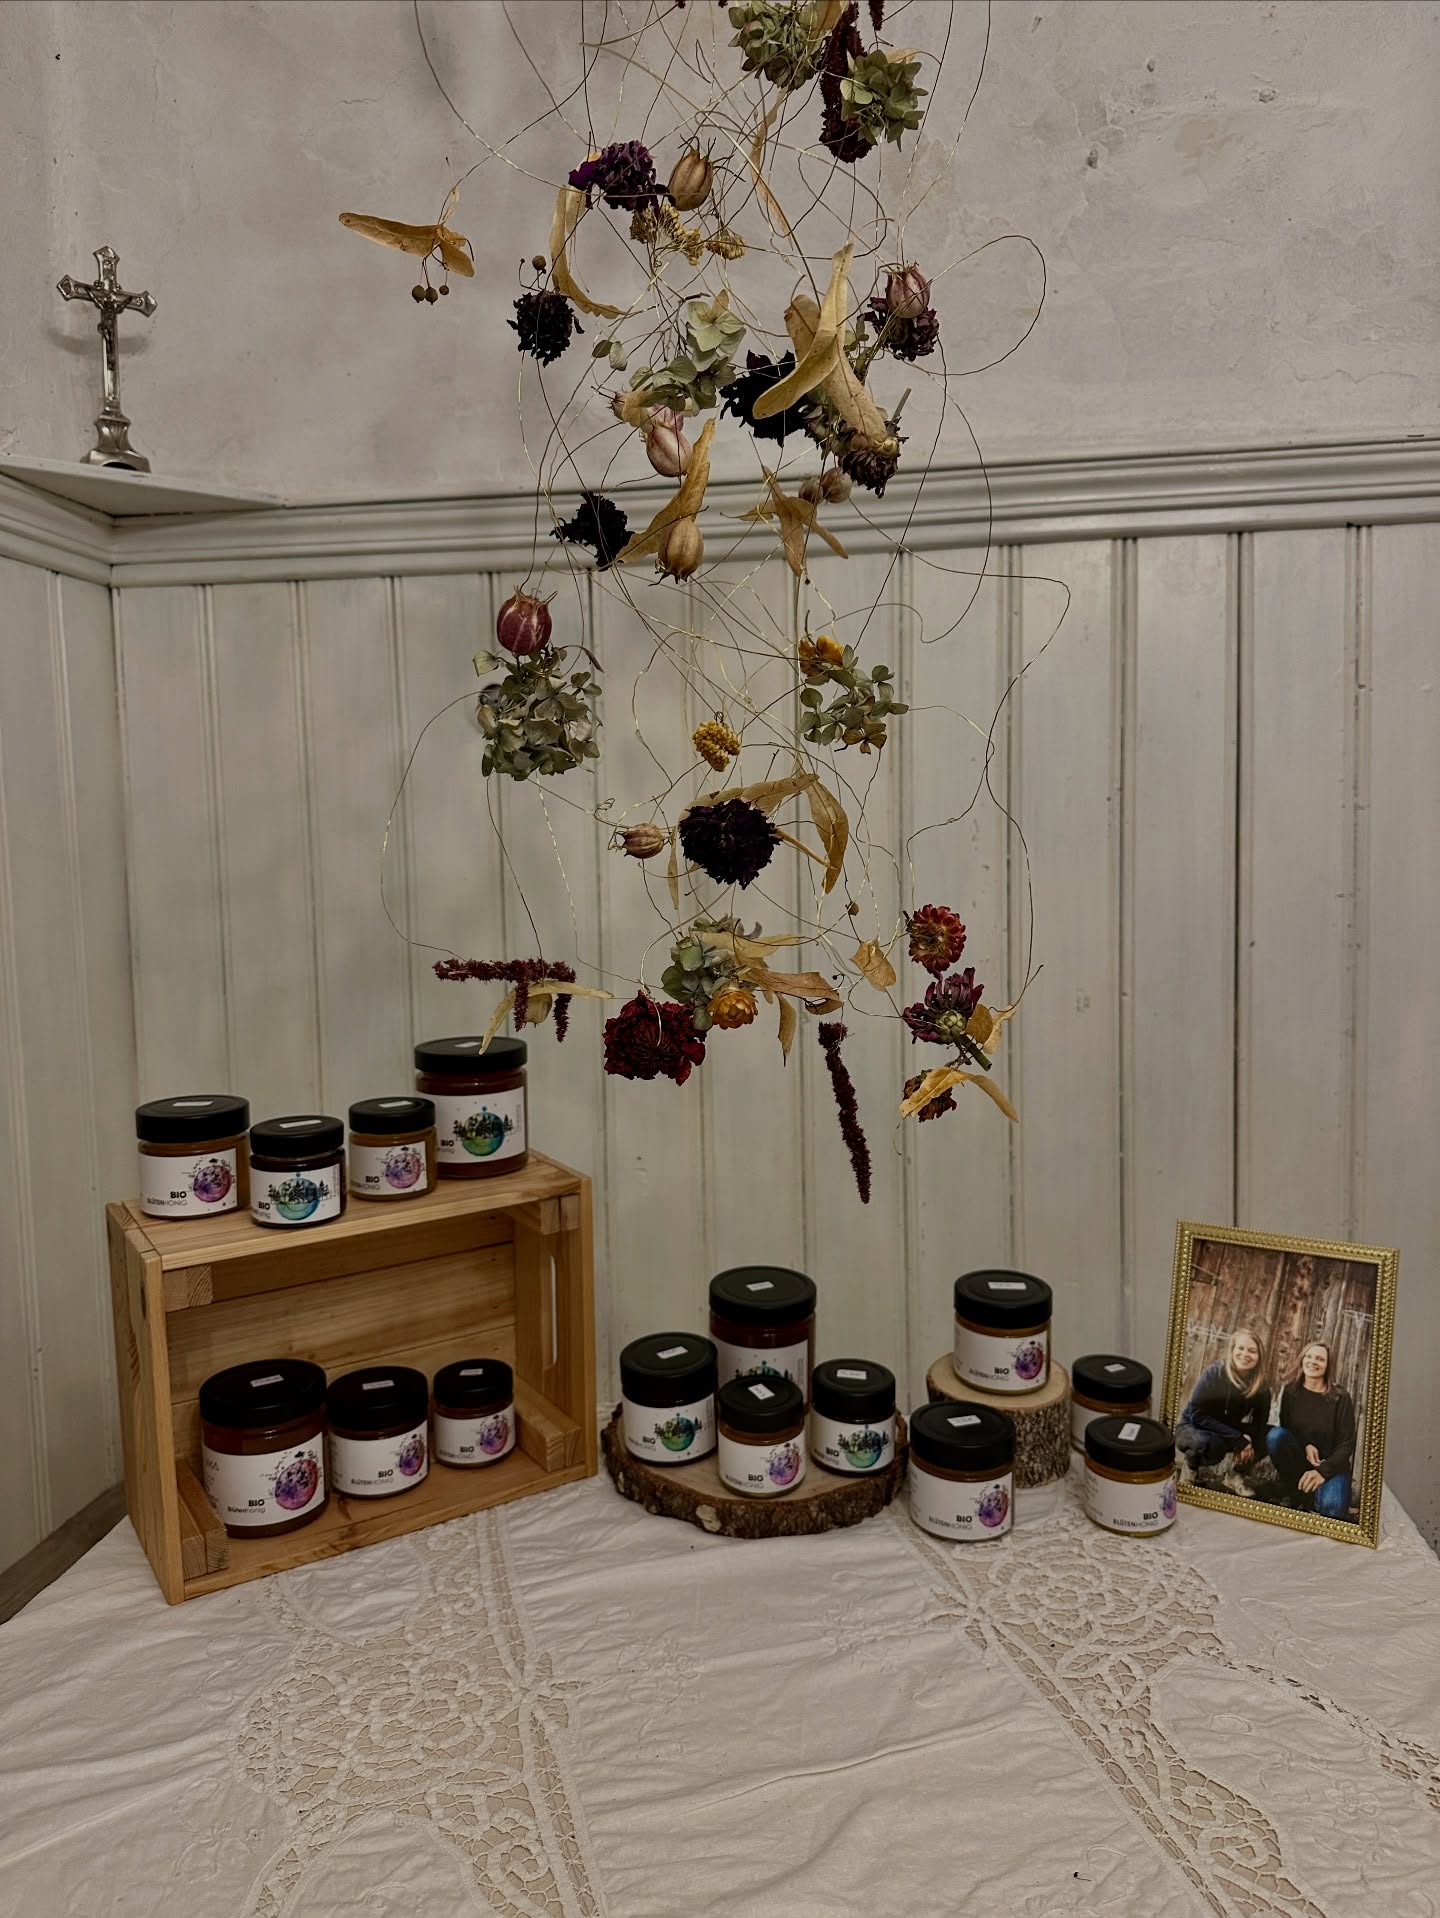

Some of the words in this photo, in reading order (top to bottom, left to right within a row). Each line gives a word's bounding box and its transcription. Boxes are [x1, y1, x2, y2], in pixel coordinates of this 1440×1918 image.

[440, 1139, 455, 1147] BIO
[365, 1175, 380, 1183] BIO
[170, 1191, 187, 1199] BIO
[258, 1201, 271, 1210] BIO
[994, 1367, 1010, 1375] BIO
[642, 1436, 656, 1445] BIO
[826, 1446, 840, 1457] BIO
[378, 1469, 394, 1478] BIO
[748, 1473, 764, 1482] BIO
[248, 1499, 265, 1507] BIO
[956, 1514, 973, 1523] BIO
[1143, 1511, 1159, 1520] BIO
